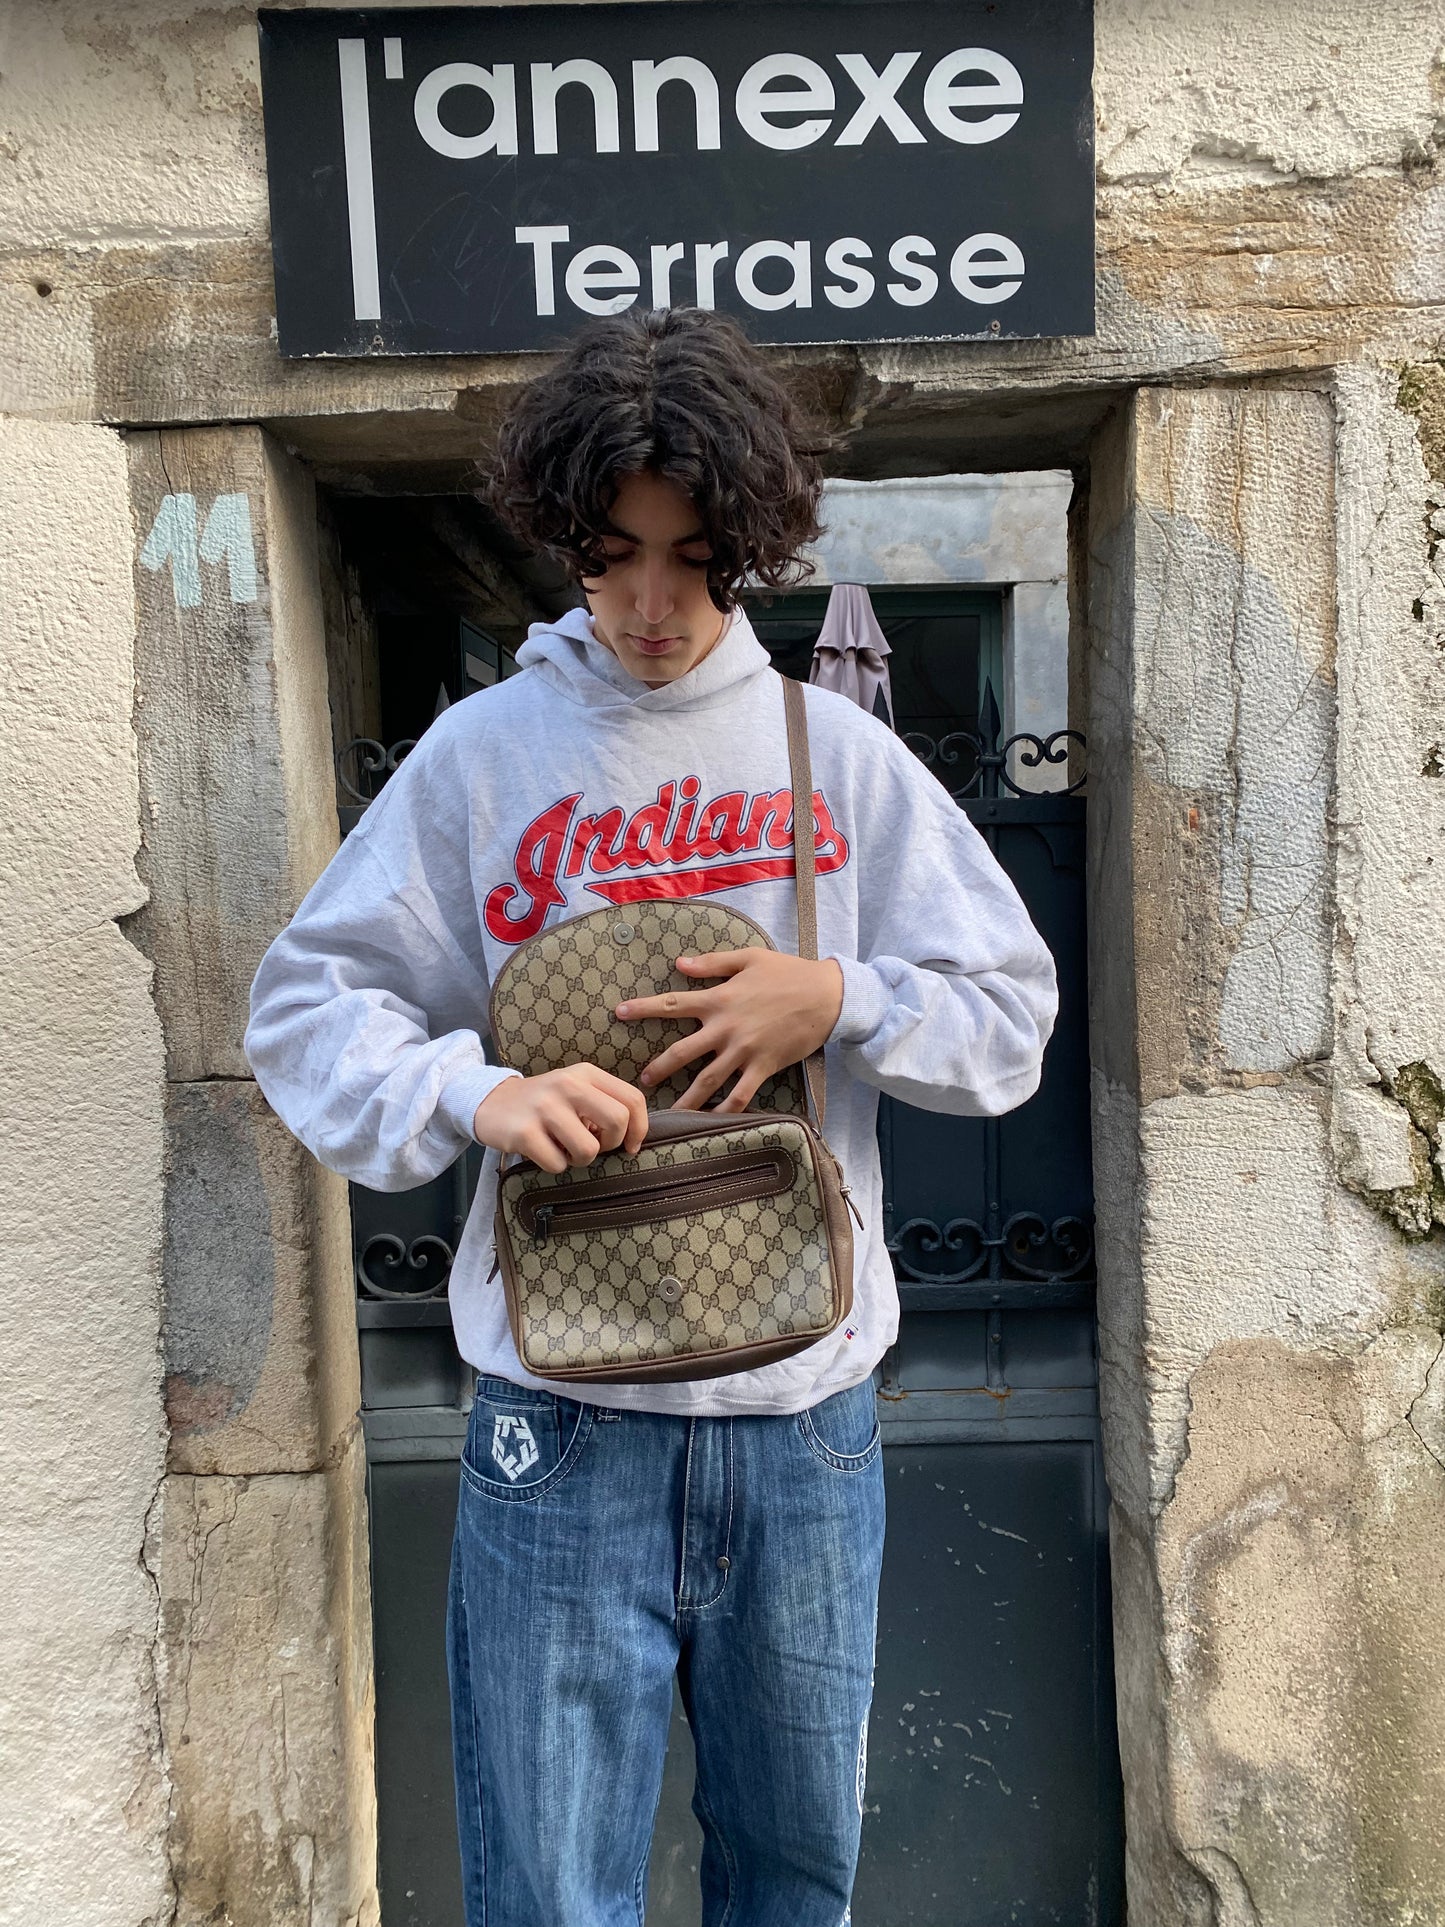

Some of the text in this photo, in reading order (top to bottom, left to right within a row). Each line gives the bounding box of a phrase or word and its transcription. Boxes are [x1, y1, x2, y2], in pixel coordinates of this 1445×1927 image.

[337, 37, 1025, 321] l'annexe
[515, 224, 1026, 318] Terrasse
[139, 492, 258, 608] 11
